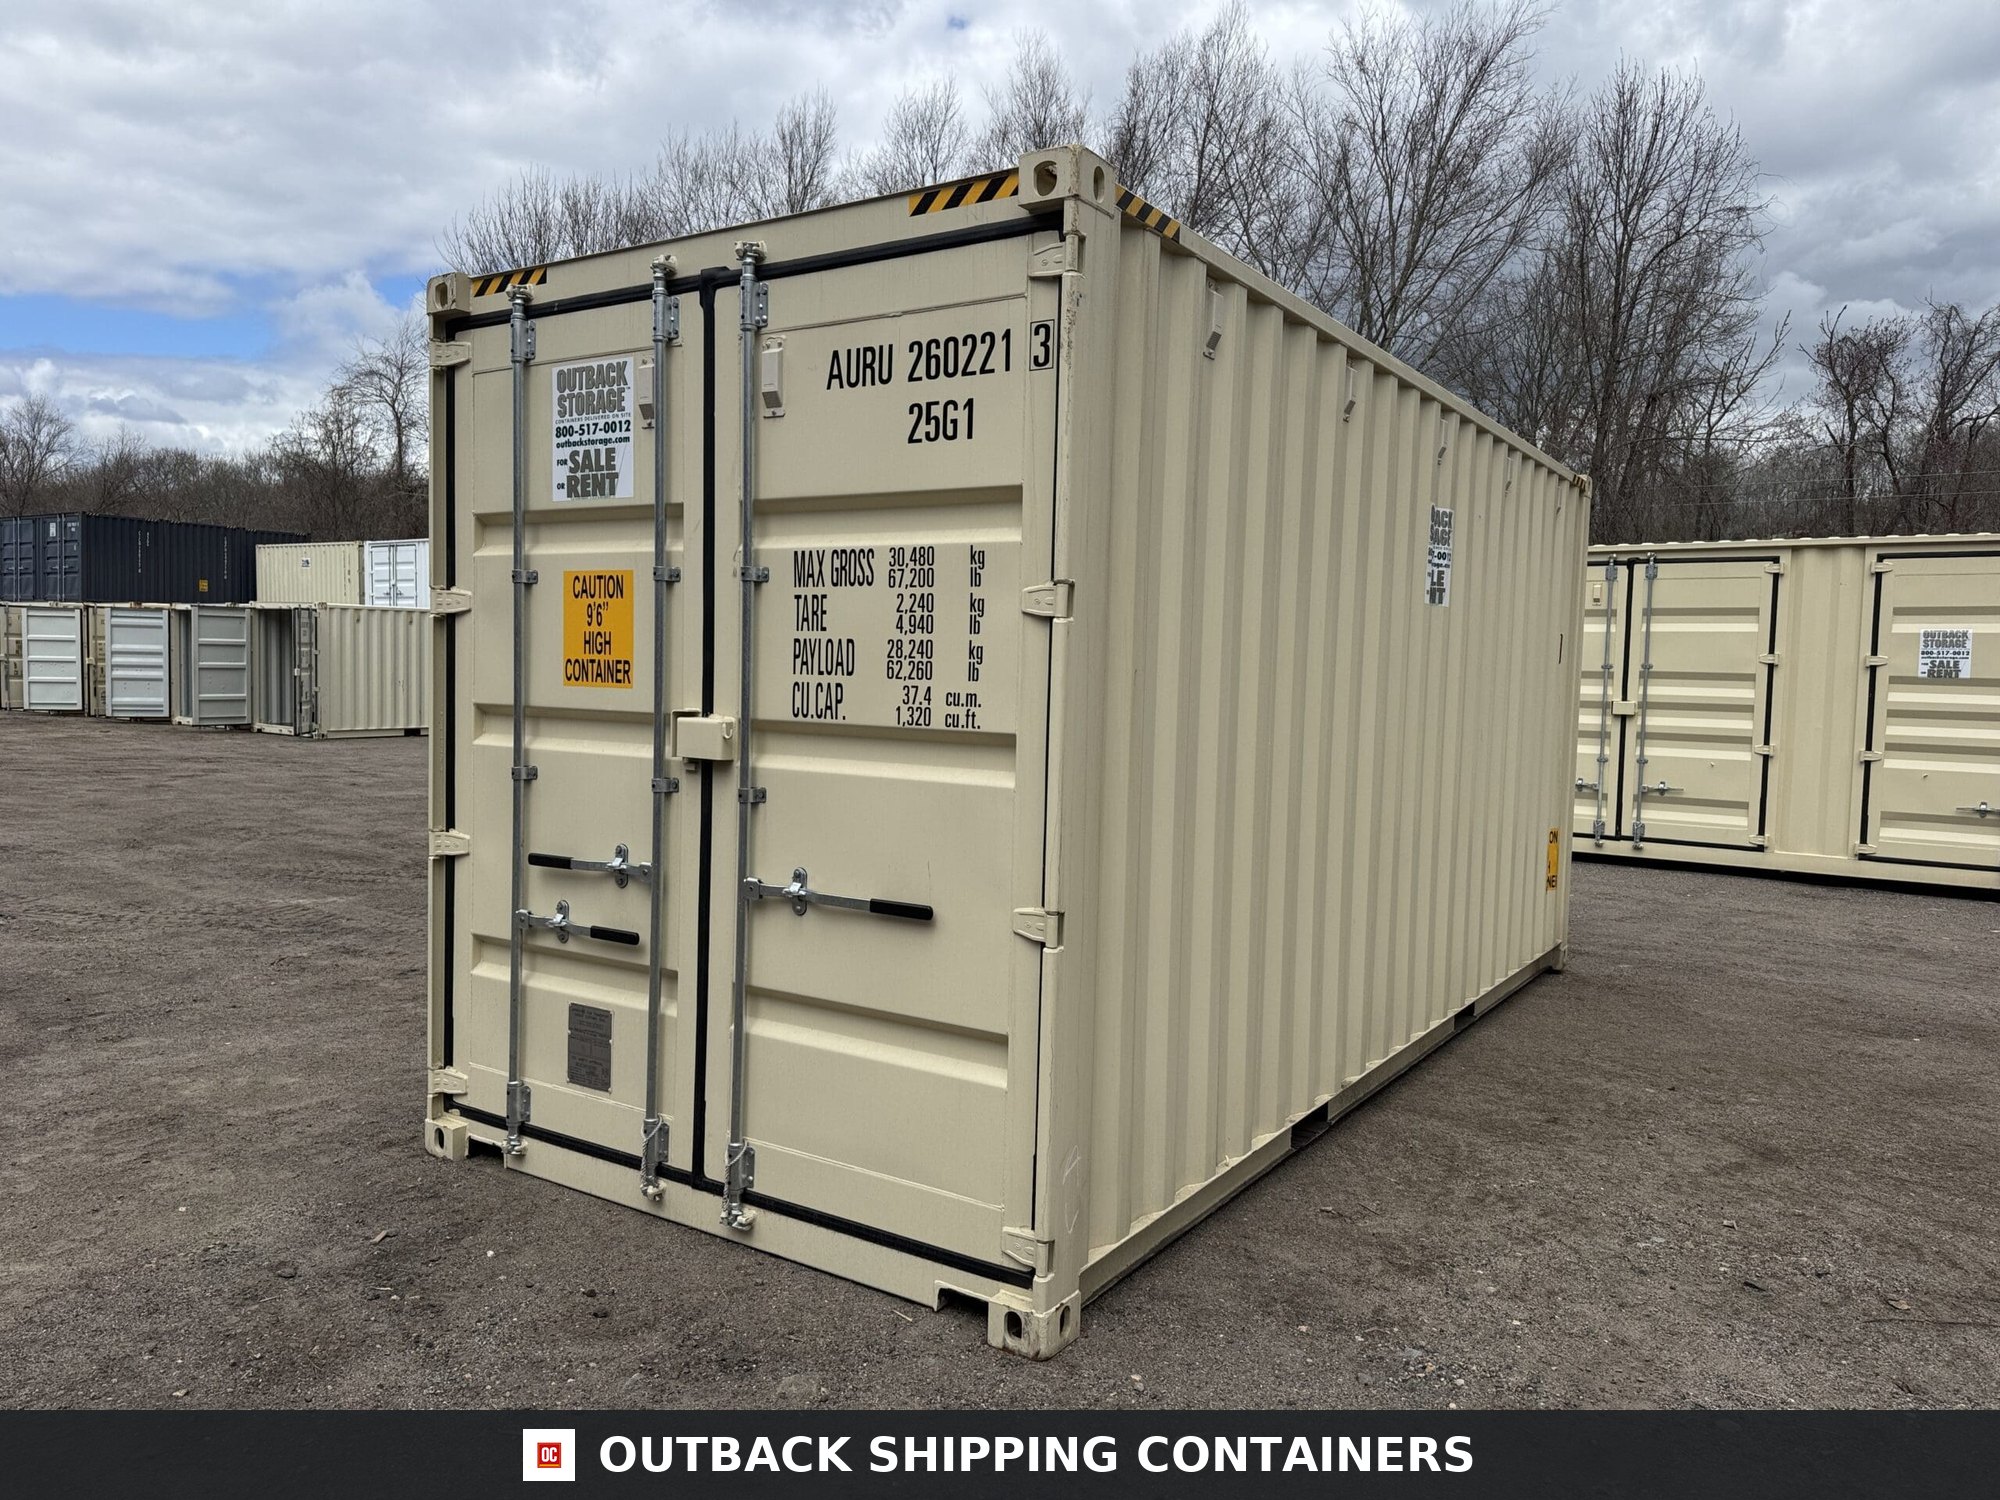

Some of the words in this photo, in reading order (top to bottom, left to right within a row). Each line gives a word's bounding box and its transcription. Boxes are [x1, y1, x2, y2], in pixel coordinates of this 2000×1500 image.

[826, 344, 893, 390] AURU
[908, 328, 1011, 382] 260221
[1033, 323, 1051, 367] 3
[557, 361, 628, 393] OUTBACK
[557, 387, 626, 418] STORAGE
[555, 420, 631, 438] 800-517-0012
[908, 398, 974, 444] 25G1
[556, 436, 630, 449] outbackstorage.com
[569, 448, 616, 474] SALE
[566, 472, 619, 498] RENT
[793, 550, 825, 588] MAX
[831, 548, 875, 587] GROSS
[889, 546, 935, 568] 30,480
[970, 545, 985, 570] kg
[888, 568, 935, 589] 67,200
[970, 567, 981, 587] lb
[573, 575, 624, 599] CAUTION
[794, 594, 827, 632] TARE
[896, 593, 934, 614] 2,240
[970, 592, 985, 617] kg
[895, 614, 934, 635] 4,940
[969, 614, 980, 635] lb
[1923, 630, 1969, 639] OUTBACK
[583, 631, 611, 655] HIGH
[1922, 639, 1967, 648] STORAGE
[793, 638, 855, 677] PAYLOAD
[887, 639, 933, 660] 28,240
[968, 640, 983, 665] kg
[1929, 660, 1960, 669] SALE
[565, 658, 631, 684] CONTAINER
[886, 660, 933, 681] 62,260
[968, 662, 979, 682] lb
[1927, 669, 1961, 678] RENT
[792, 681, 846, 720] CU.CAP.
[902, 685, 932, 706] 37.4
[945, 692, 982, 708] cu.m.
[895, 705, 931, 727] 1,320
[944, 709, 981, 729] cu.ft.
